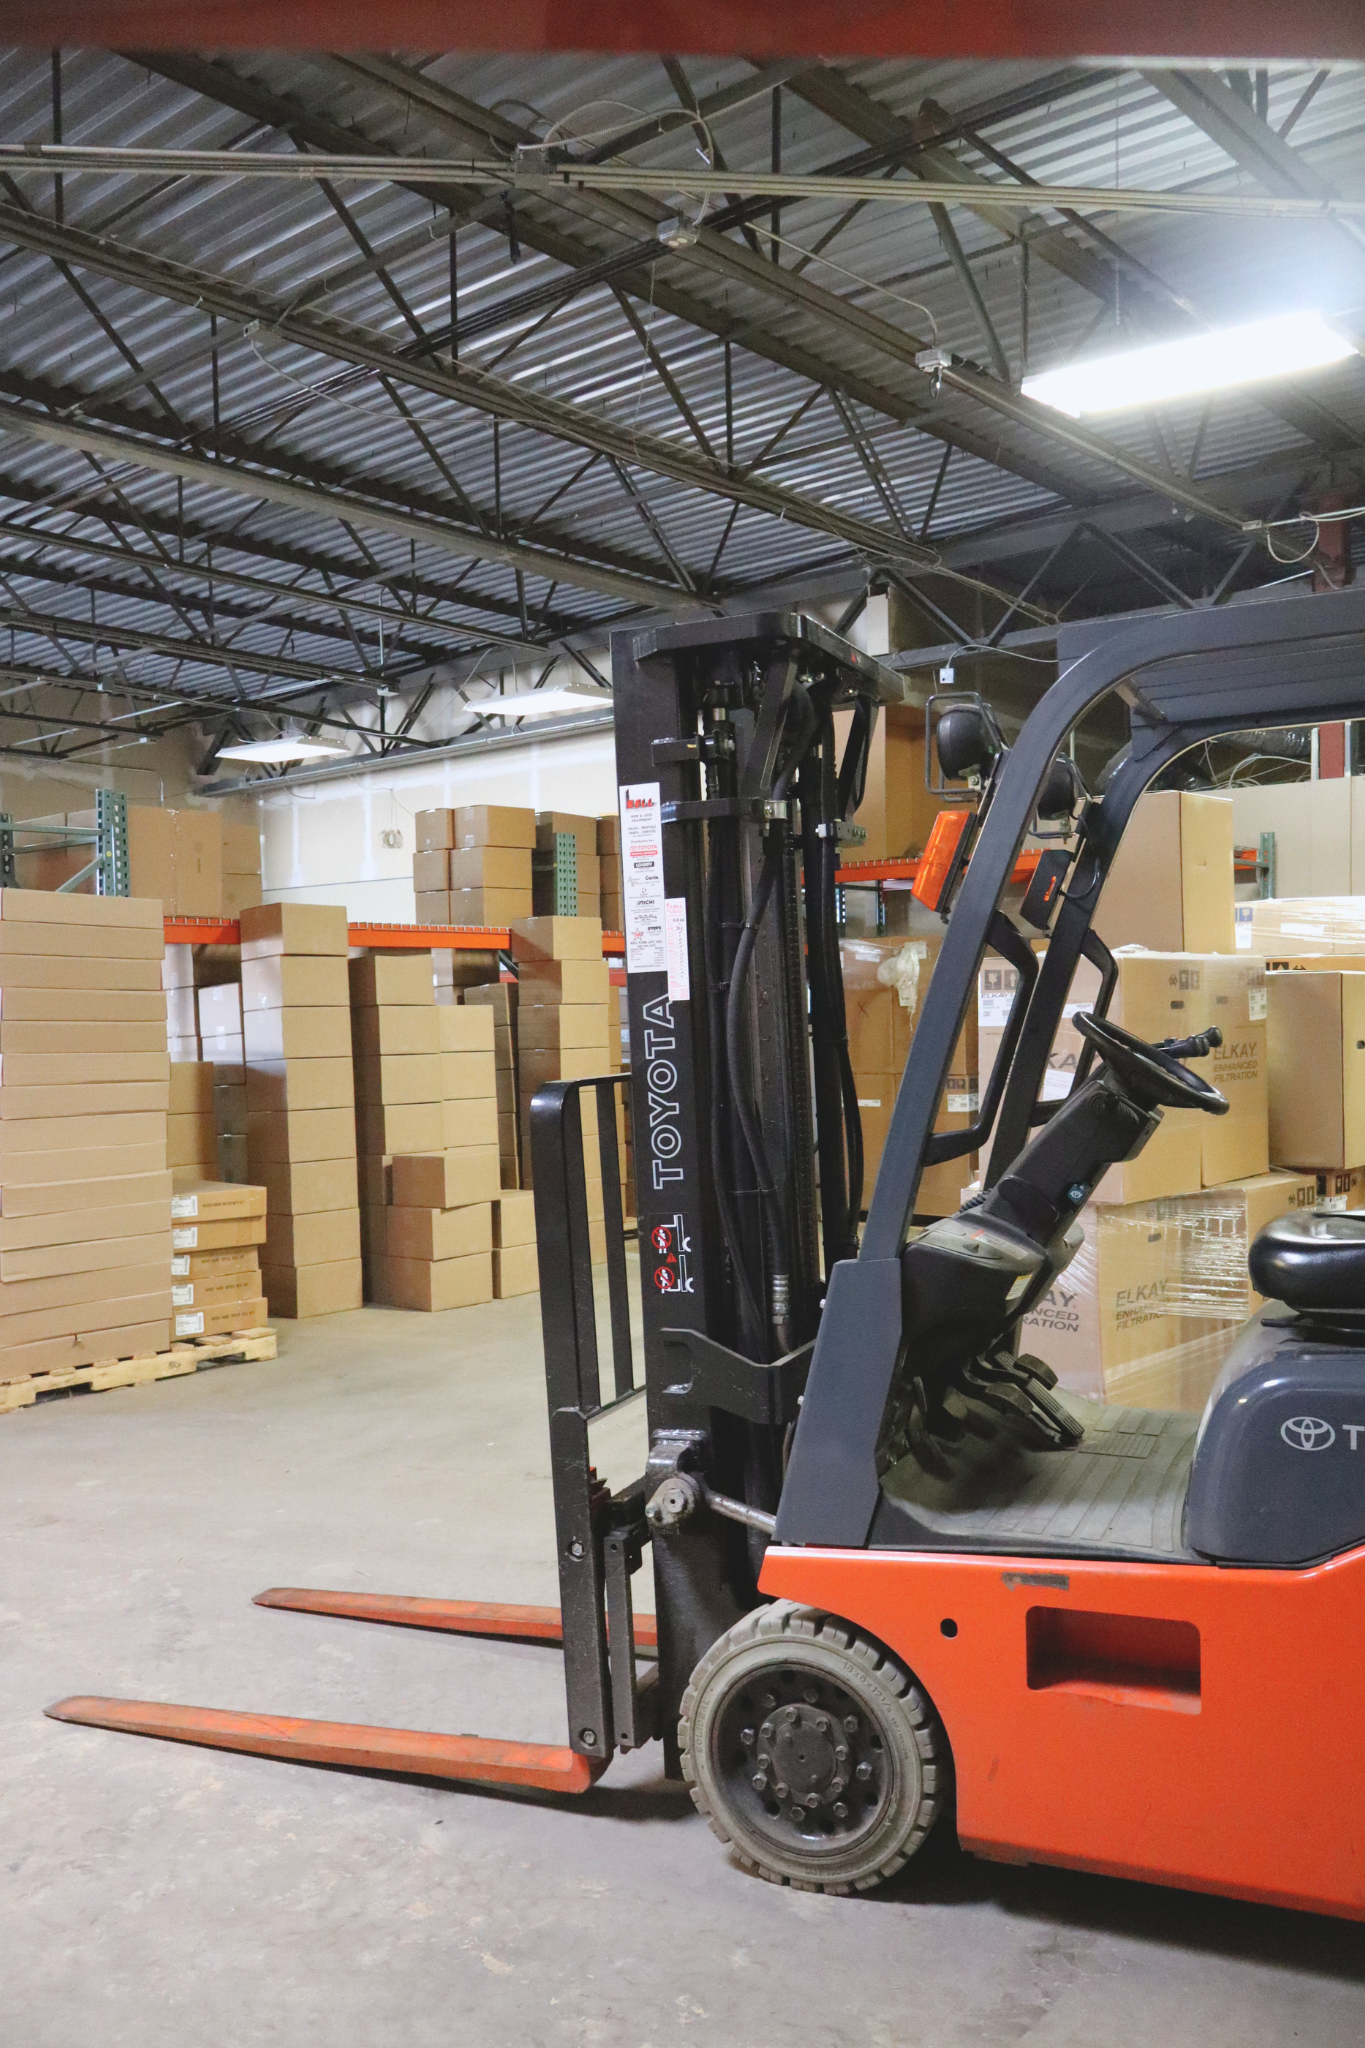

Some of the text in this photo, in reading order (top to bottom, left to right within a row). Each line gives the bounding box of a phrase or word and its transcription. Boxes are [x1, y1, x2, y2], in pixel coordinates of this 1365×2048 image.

[1213, 1042, 1257, 1060] ELKAY
[1213, 1060, 1258, 1072] ENHANCED
[1214, 1071, 1258, 1083] FILTRATION
[643, 993, 684, 1190] TOYOTA
[1116, 1278, 1169, 1308] ELKAY
[1031, 1308, 1079, 1321] NCED
[1023, 1316, 1080, 1332] RATION
[695, 1699, 710, 1753] SOLIDEAL
